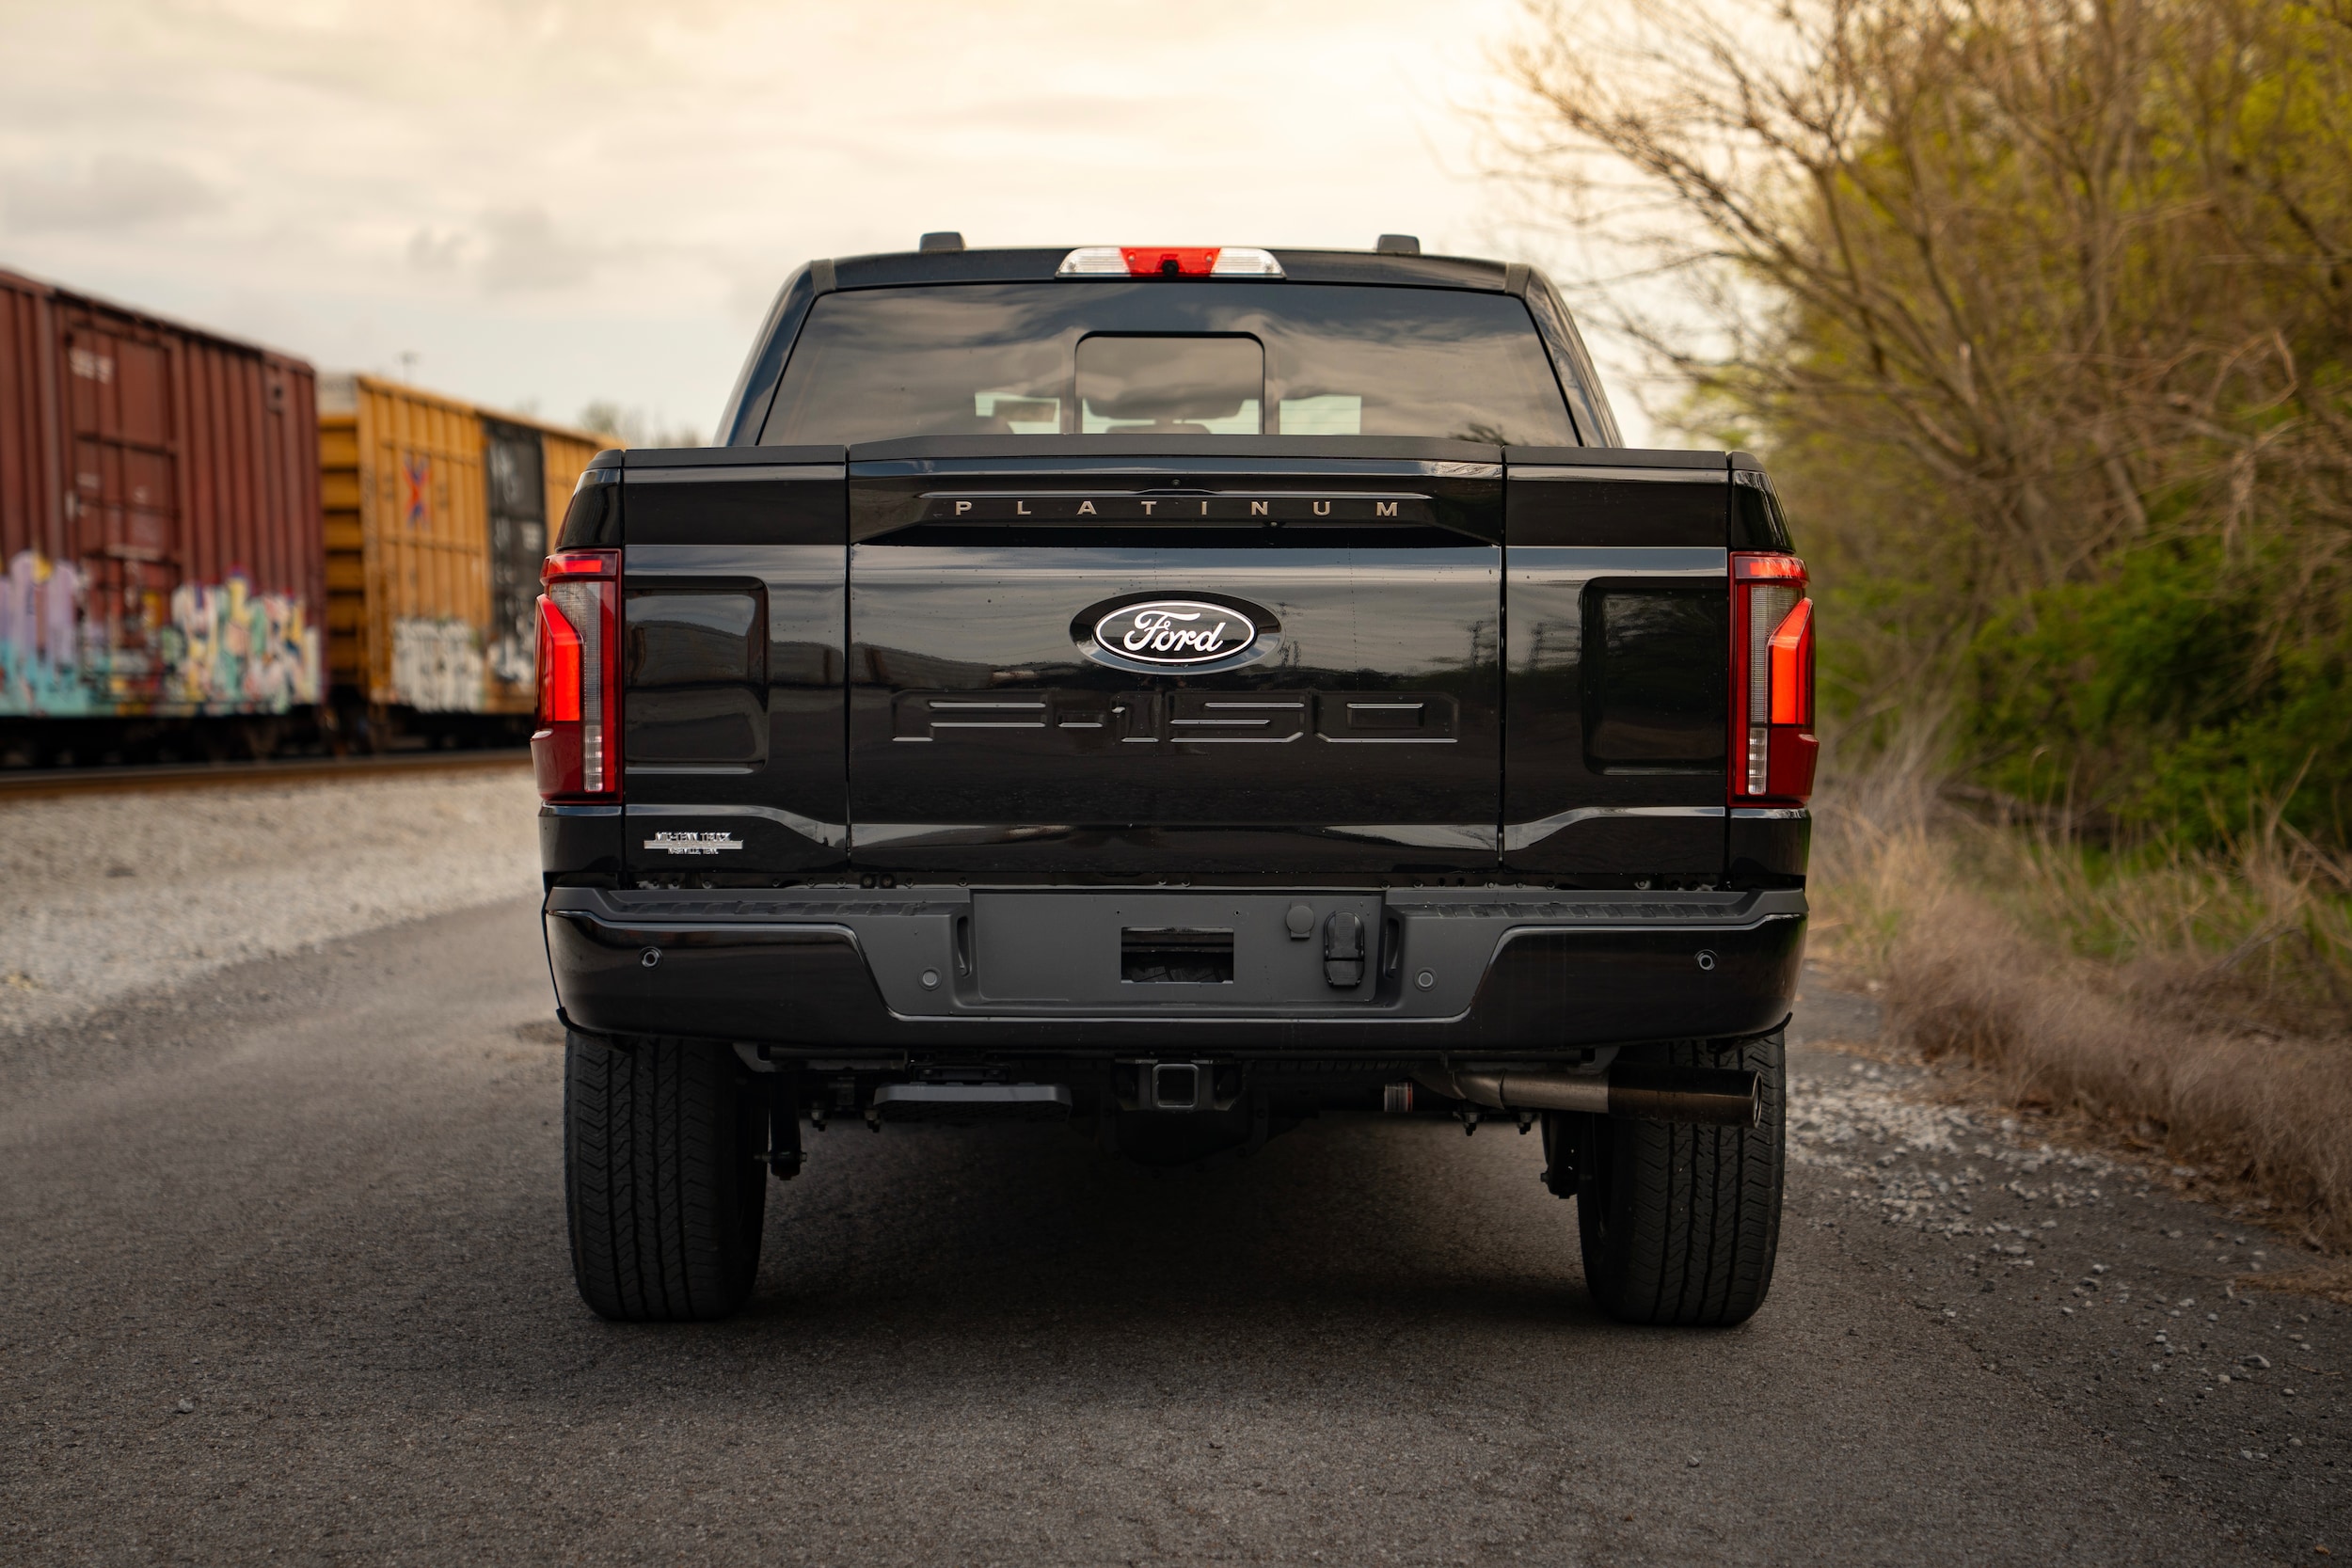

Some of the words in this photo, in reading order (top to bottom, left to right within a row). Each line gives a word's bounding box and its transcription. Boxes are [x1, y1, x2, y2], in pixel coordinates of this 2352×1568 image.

[954, 500, 1400, 516] PLATINUM
[1123, 610, 1226, 653] Ford
[891, 689, 1460, 743] F-150
